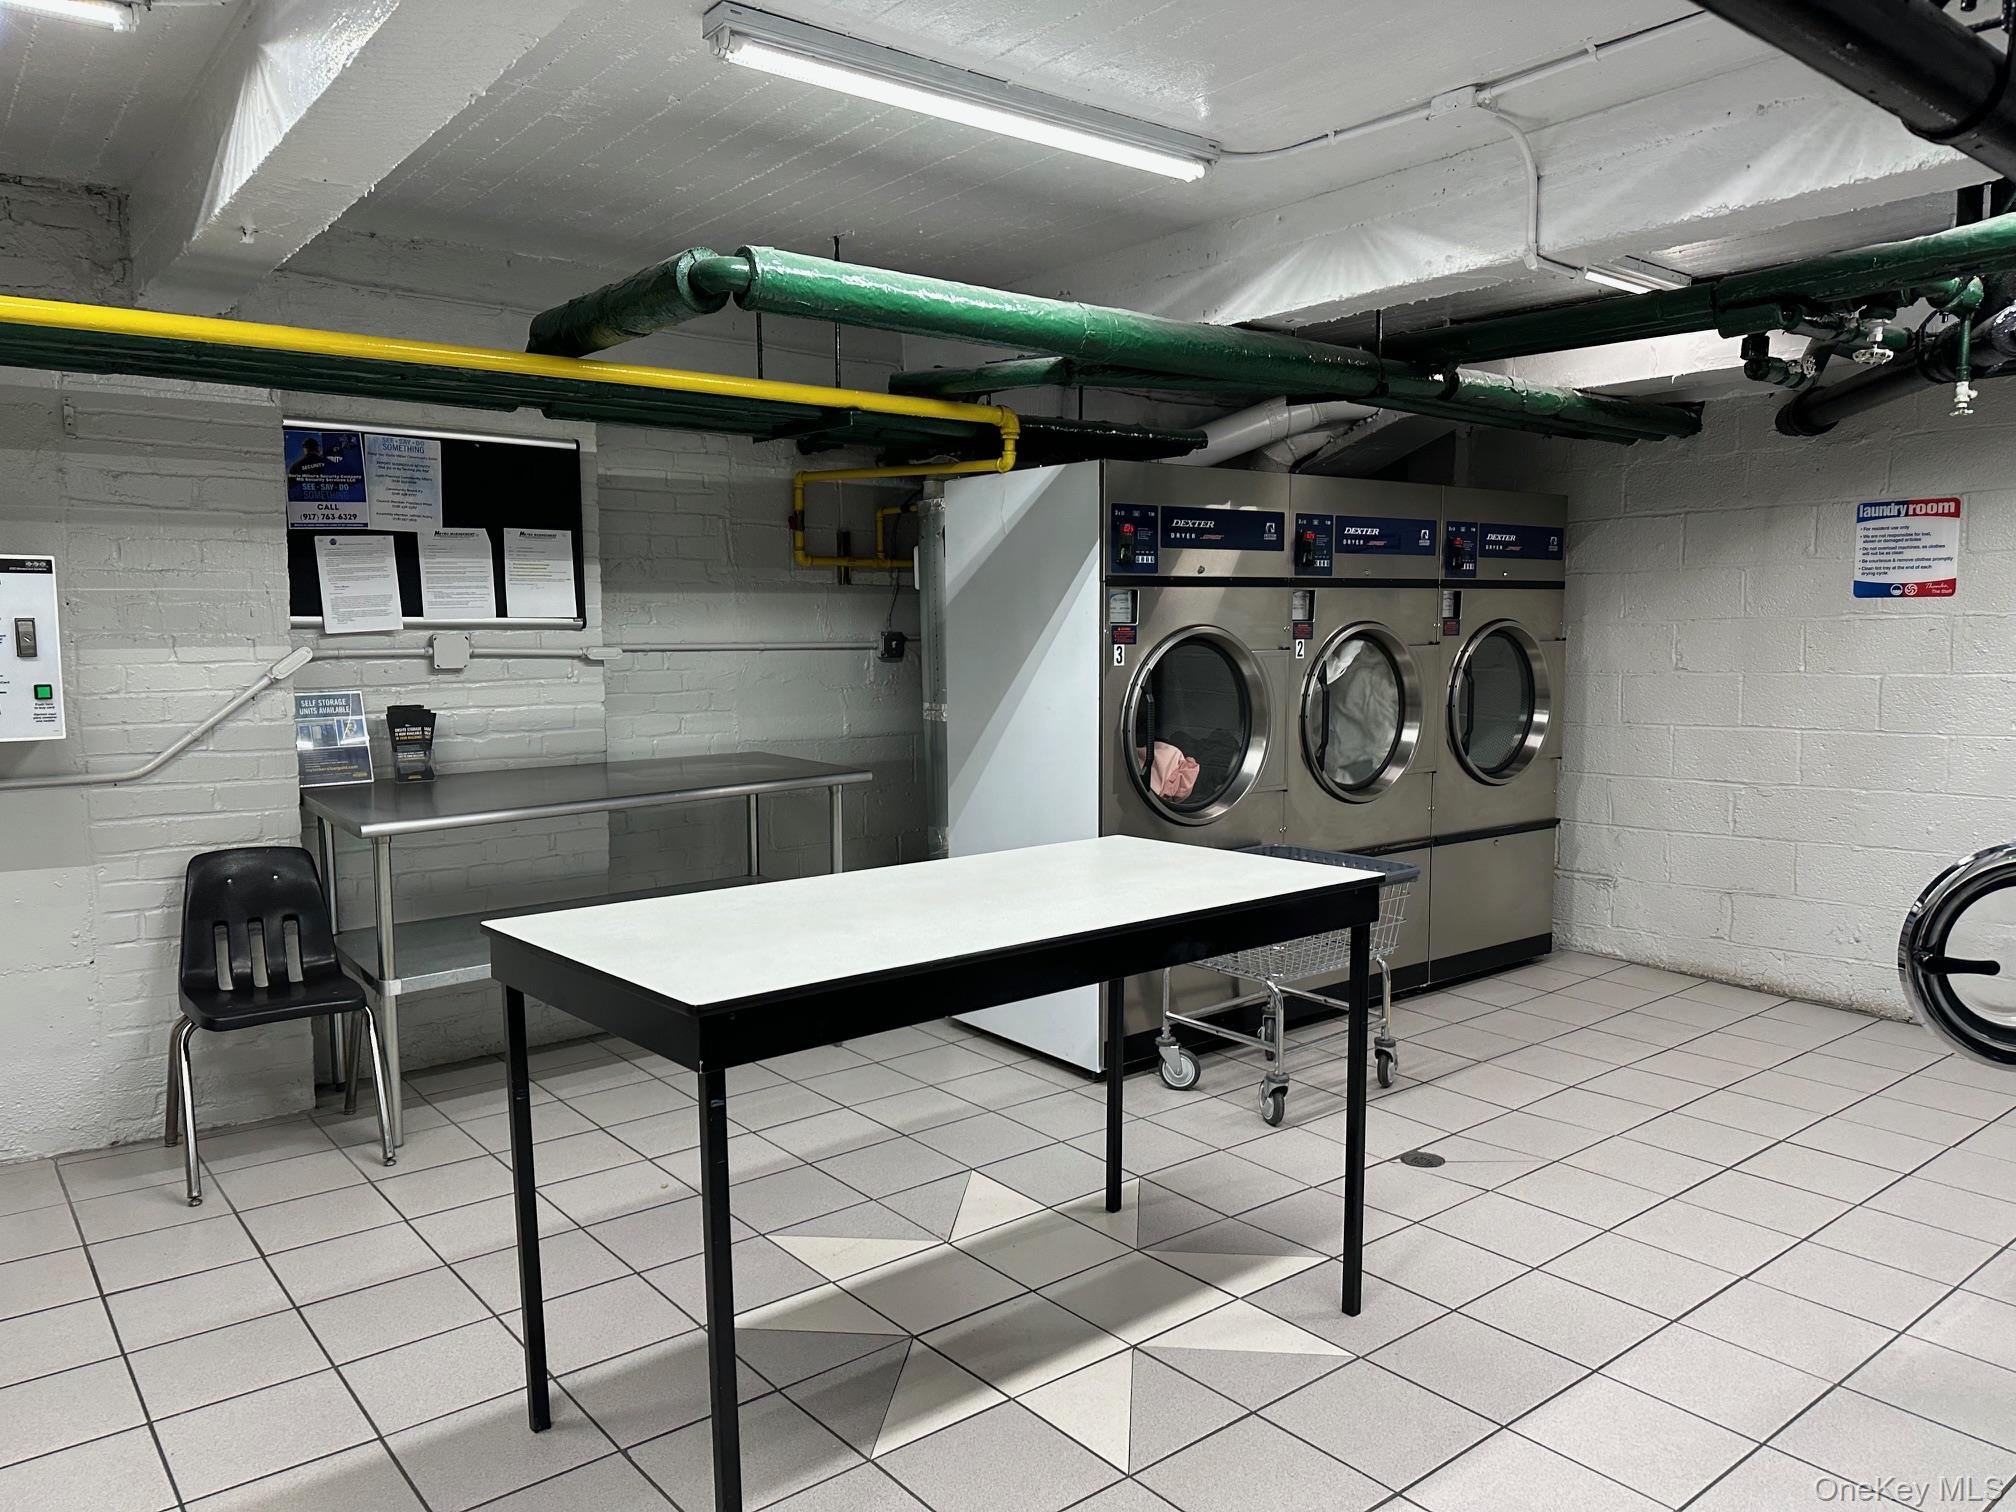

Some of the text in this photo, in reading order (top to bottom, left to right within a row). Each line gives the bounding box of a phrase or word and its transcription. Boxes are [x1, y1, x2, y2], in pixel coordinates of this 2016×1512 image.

[382, 444, 424, 453] SOMETHING
[304, 491, 350, 500] SOMETHING
[1859, 501, 1955, 517] laundry room
[1171, 519, 1215, 529] DEXTER
[1344, 527, 1380, 536] DEXTER
[1486, 533, 1516, 542] DEXTER
[1297, 641, 1304, 657] 2
[1116, 646, 1122, 664] 3
[318, 698, 346, 706] STORAGE
[300, 705, 350, 715] UNITS AVAILABLE
